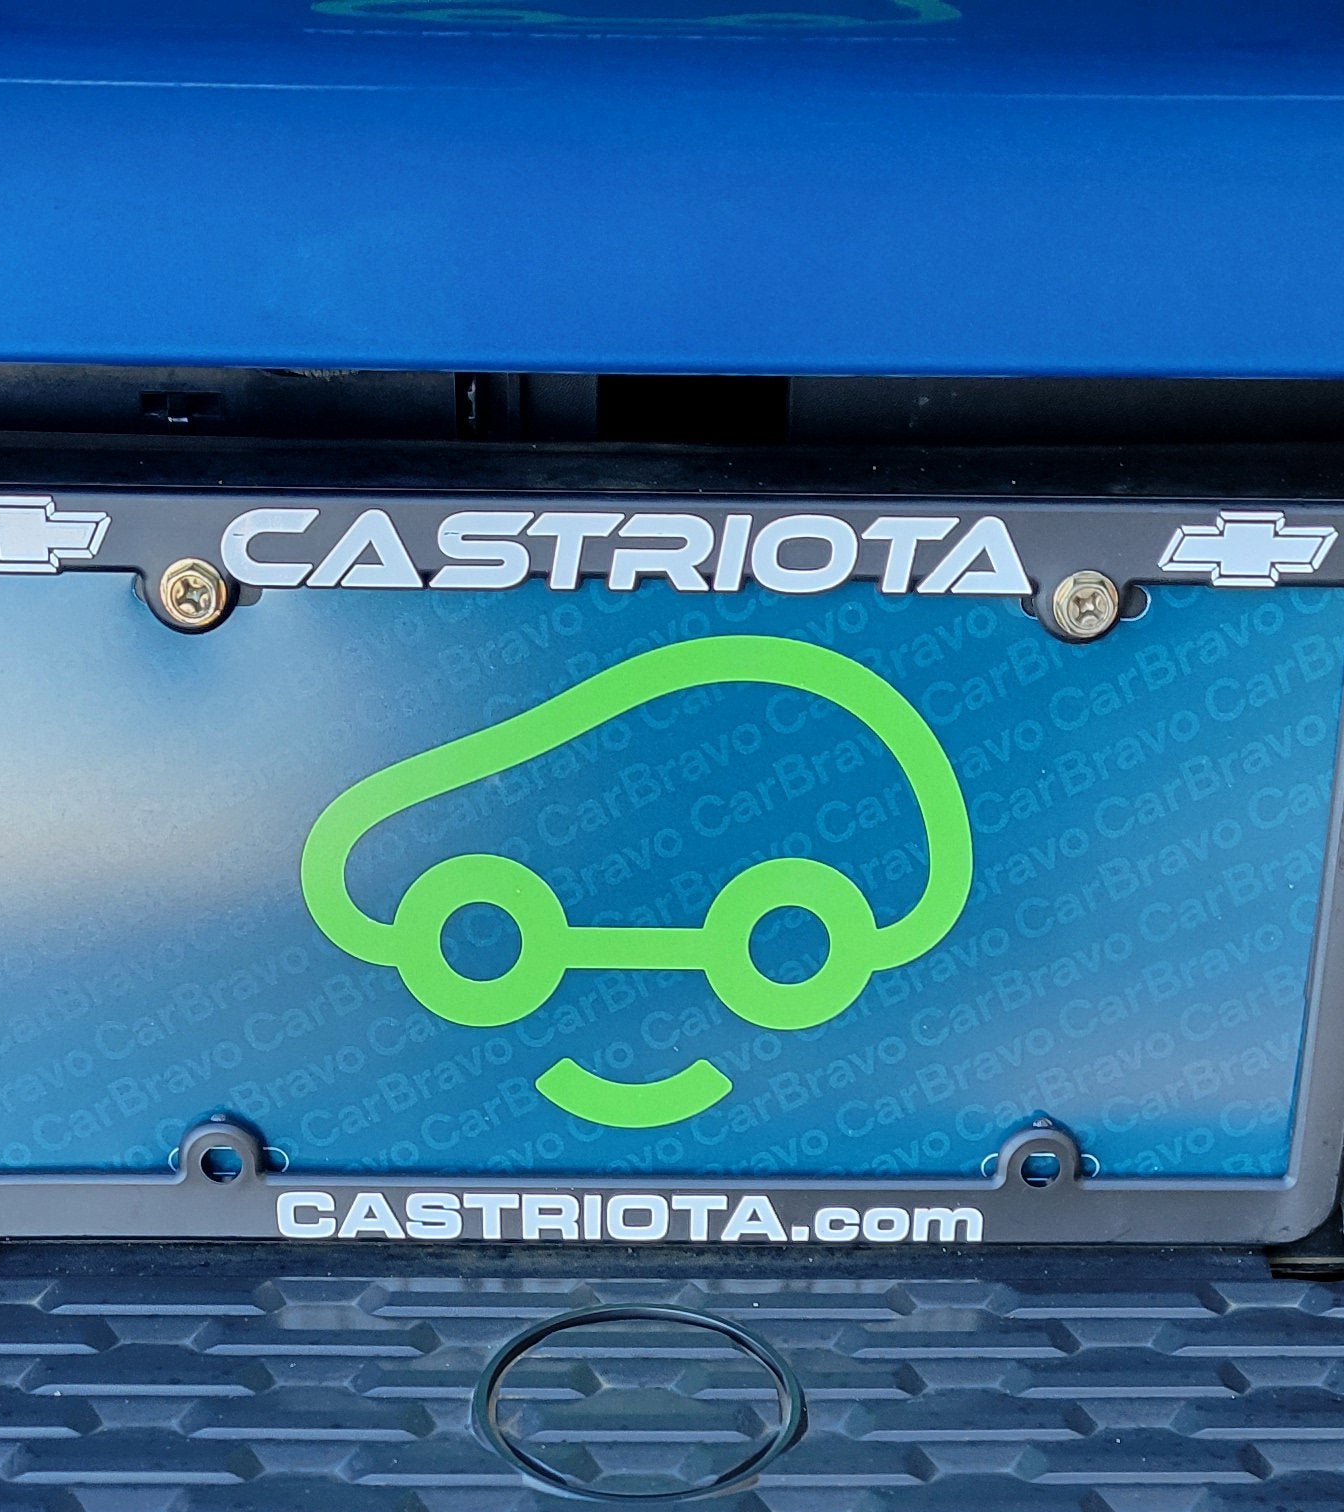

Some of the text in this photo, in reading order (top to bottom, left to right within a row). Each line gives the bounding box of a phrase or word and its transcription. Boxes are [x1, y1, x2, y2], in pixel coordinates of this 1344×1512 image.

[220, 508, 1034, 595] CASTRIOTA
[357, 603, 584, 729] CarBravo
[1049, 603, 1284, 731] CarBravo
[1094, 714, 1327, 838] CarBravo
[94, 946, 309, 1059] CarBravo
[537, 723, 763, 845] CarBravo
[300, 1037, 513, 1147] CarBravo
[971, 710, 1200, 833] CarBravo
[1015, 819, 1242, 938] CarBravo
[690, 1036, 907, 1145] CarBravo
[910, 932, 1133, 1046] CarBravo
[835, 923, 1283, 1137] CarBravo CarBravo
[956, 1032, 1175, 1140] CarBravo
[32, 1042, 243, 1151] CarBravo
[274, 1190, 984, 1242] CASTRIOTA.com
